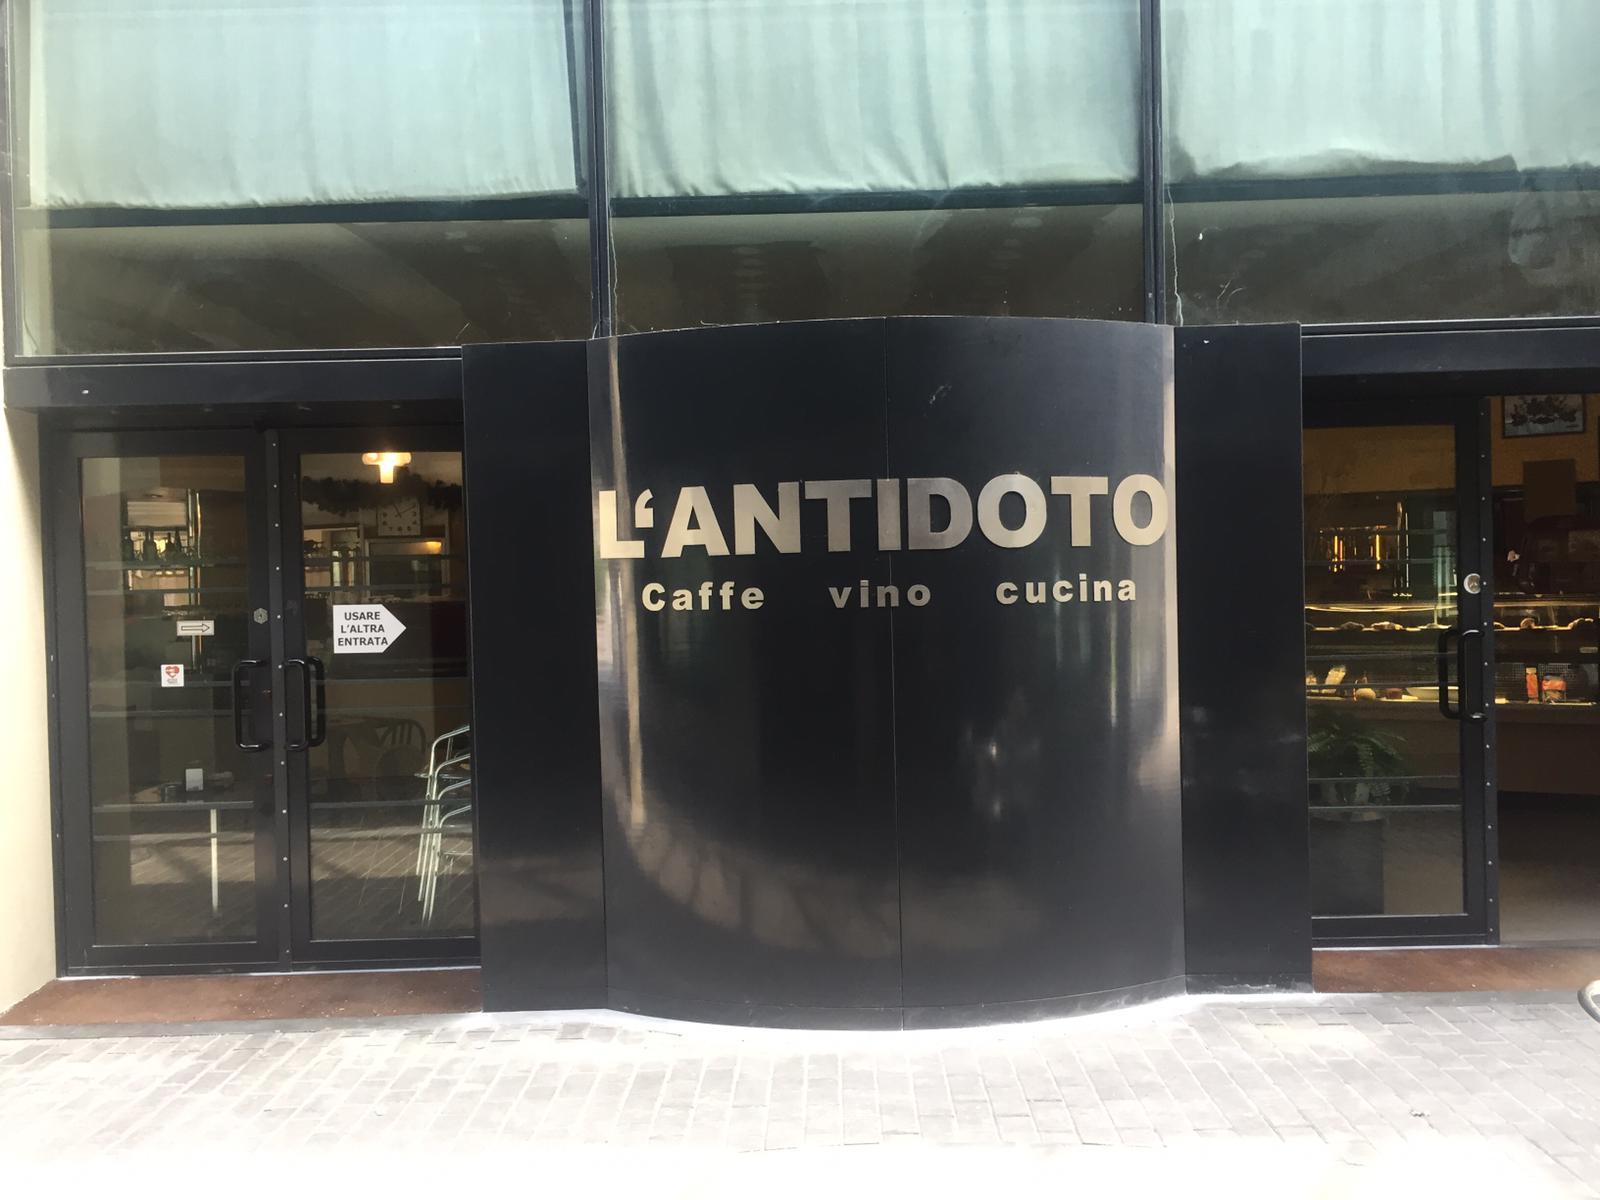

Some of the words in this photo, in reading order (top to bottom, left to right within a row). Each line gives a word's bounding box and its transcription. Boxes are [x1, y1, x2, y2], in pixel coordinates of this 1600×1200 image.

[598, 474, 1168, 559] L'ANTIDOTO
[641, 581, 765, 612] Caffe
[828, 579, 932, 608] vino
[995, 573, 1137, 605] cucina
[344, 611, 381, 621] USARE
[340, 624, 385, 634] L'ALTRA
[337, 637, 388, 647] ENTRATA
